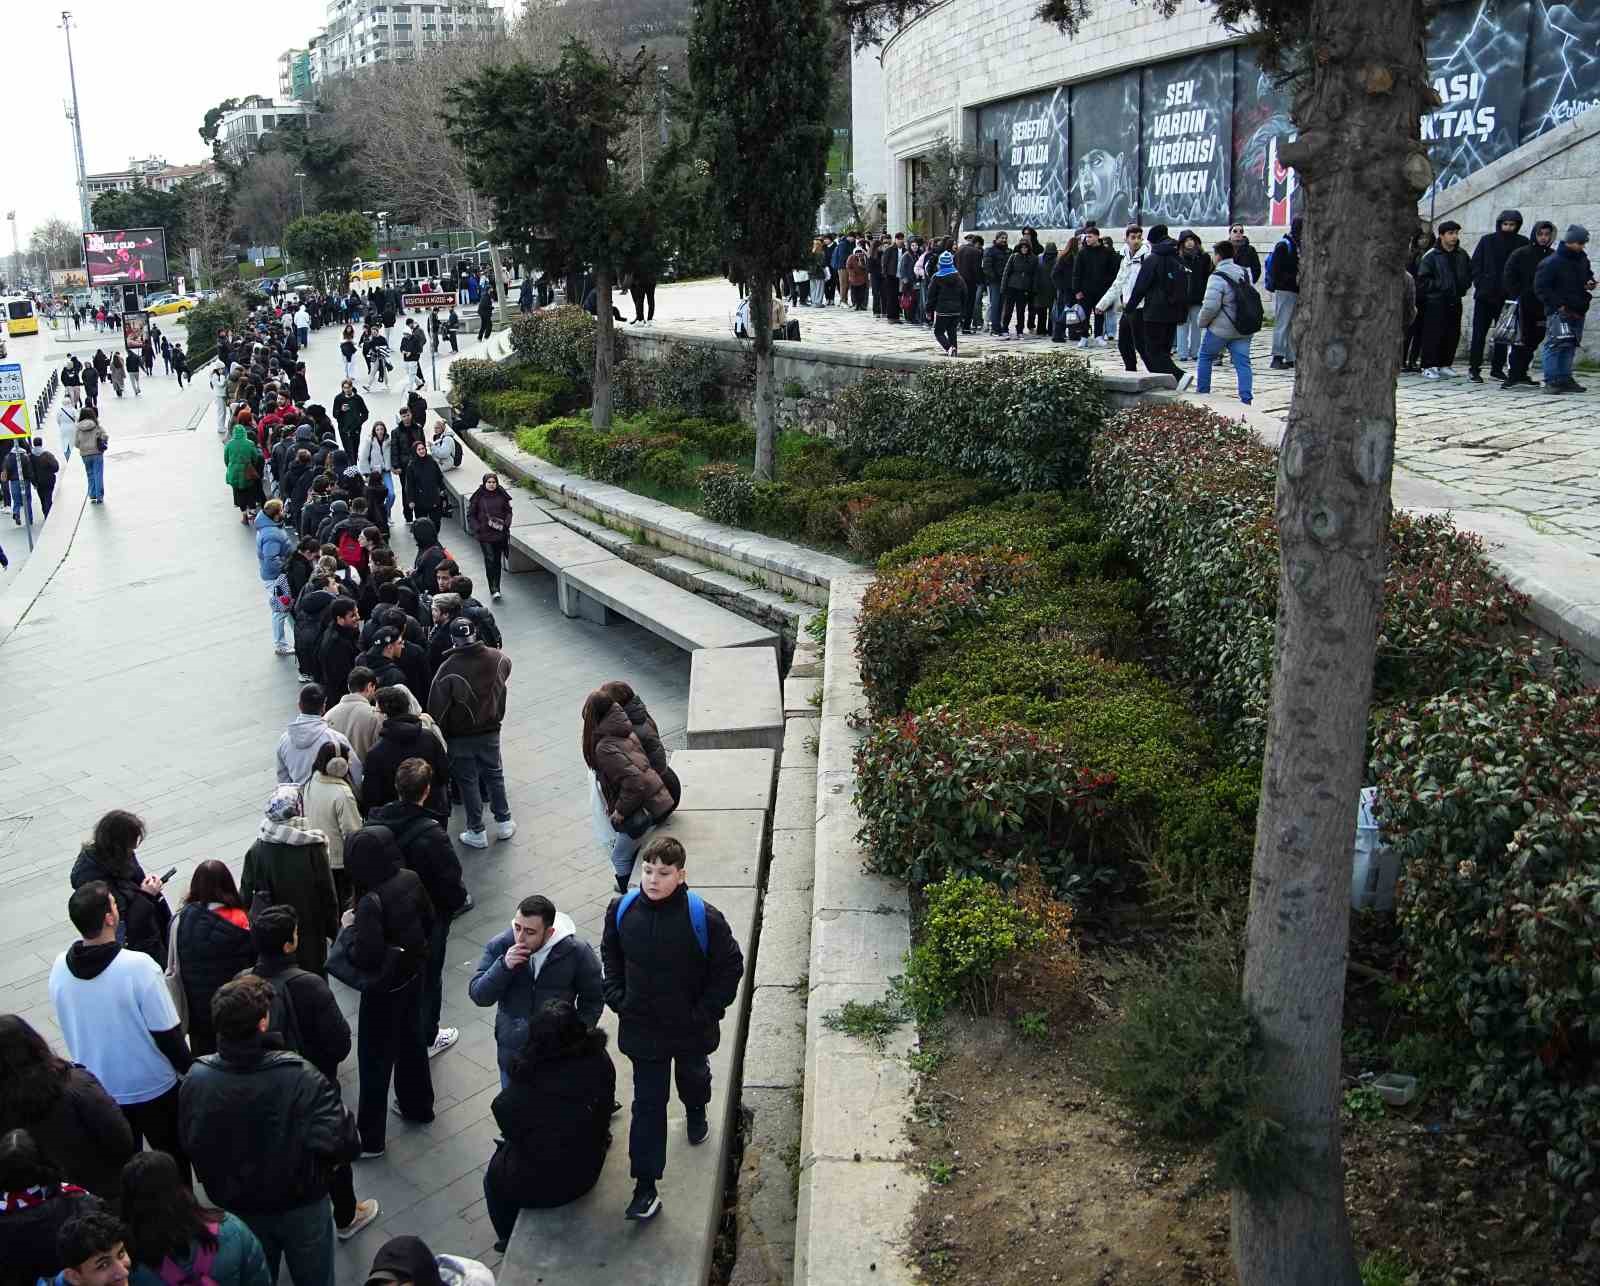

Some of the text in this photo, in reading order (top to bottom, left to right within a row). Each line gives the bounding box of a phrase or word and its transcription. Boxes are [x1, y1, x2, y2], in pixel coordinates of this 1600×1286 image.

[1165, 79, 1195, 107] SEN
[1432, 72, 1479, 104] ASI
[1153, 109, 1207, 139] VARDIN
[1420, 106, 1496, 142] KTAŞ
[1011, 144, 1049, 167] BU YOLDA
[1154, 169, 1209, 196] YOKKEN
